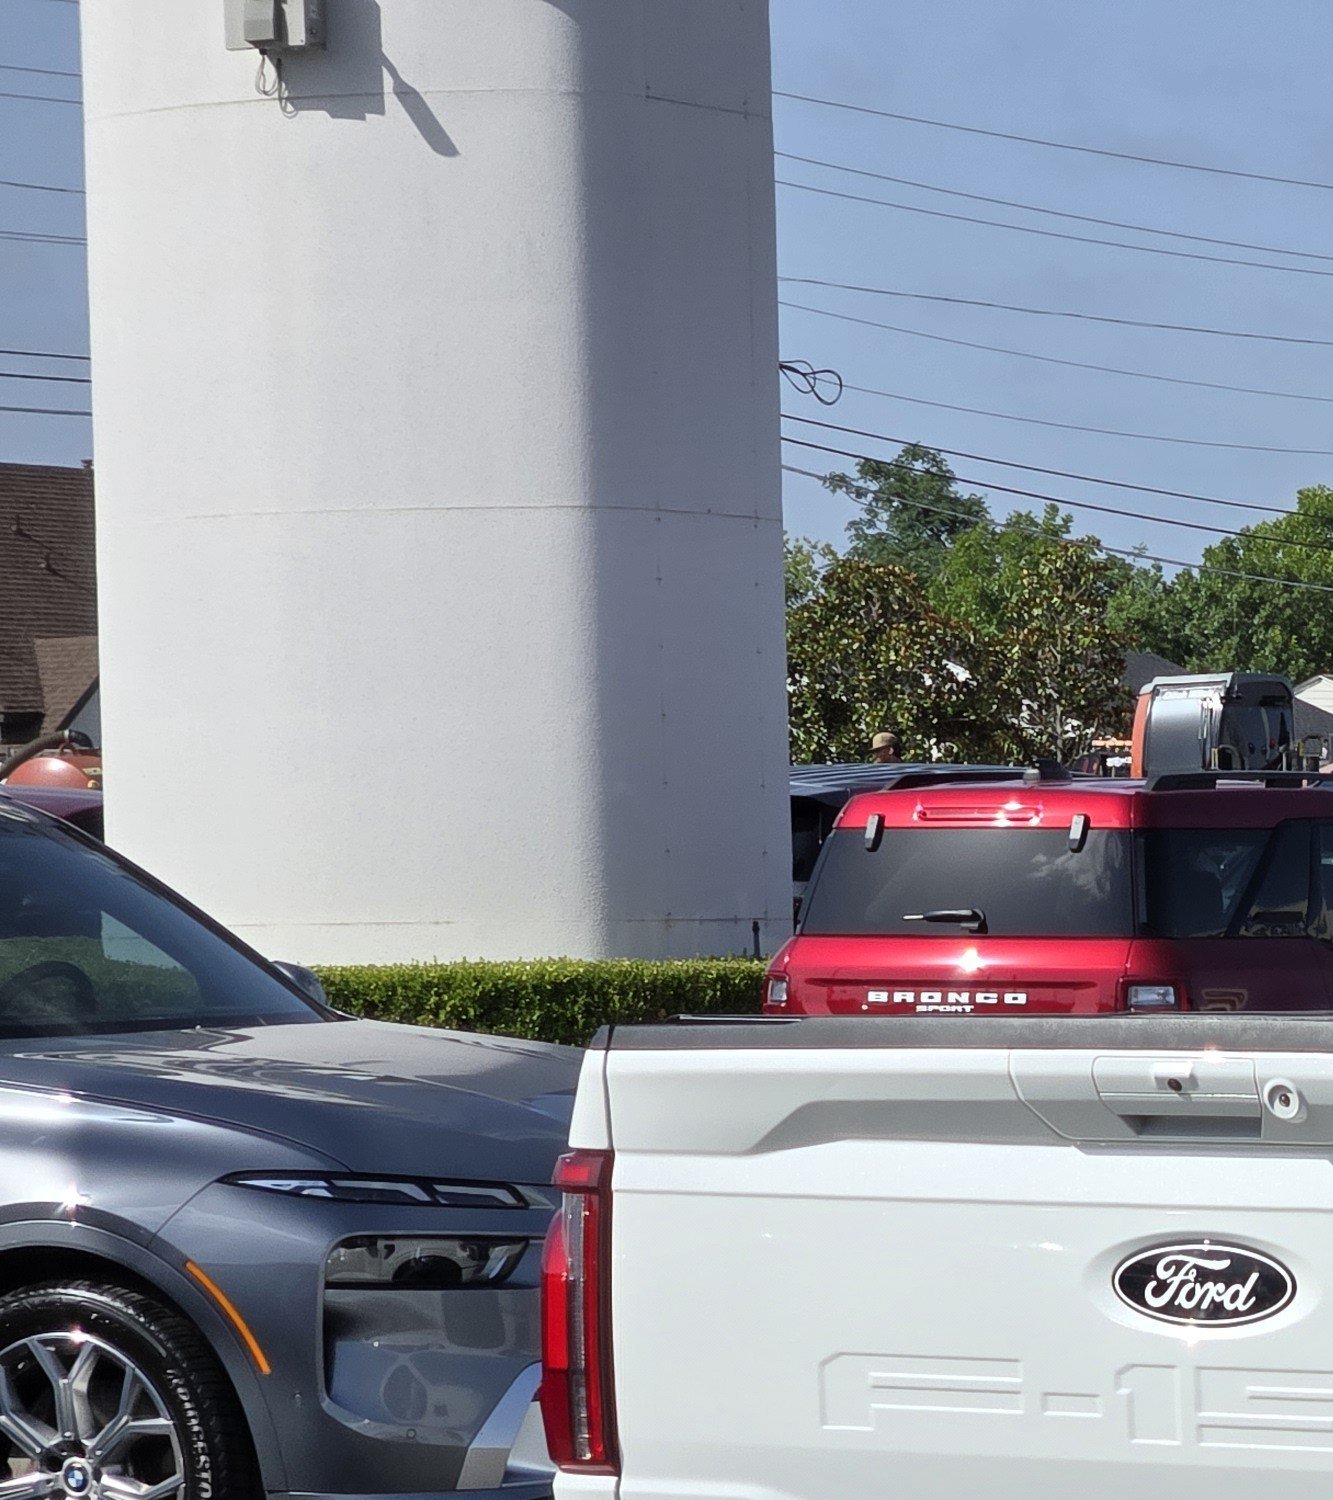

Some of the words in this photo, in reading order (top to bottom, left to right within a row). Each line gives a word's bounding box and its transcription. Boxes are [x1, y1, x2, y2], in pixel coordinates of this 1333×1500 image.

[867, 991, 1028, 1005] BRONCO
[915, 1004, 975, 1013] SPORT
[1144, 1254, 1260, 1312] Ford
